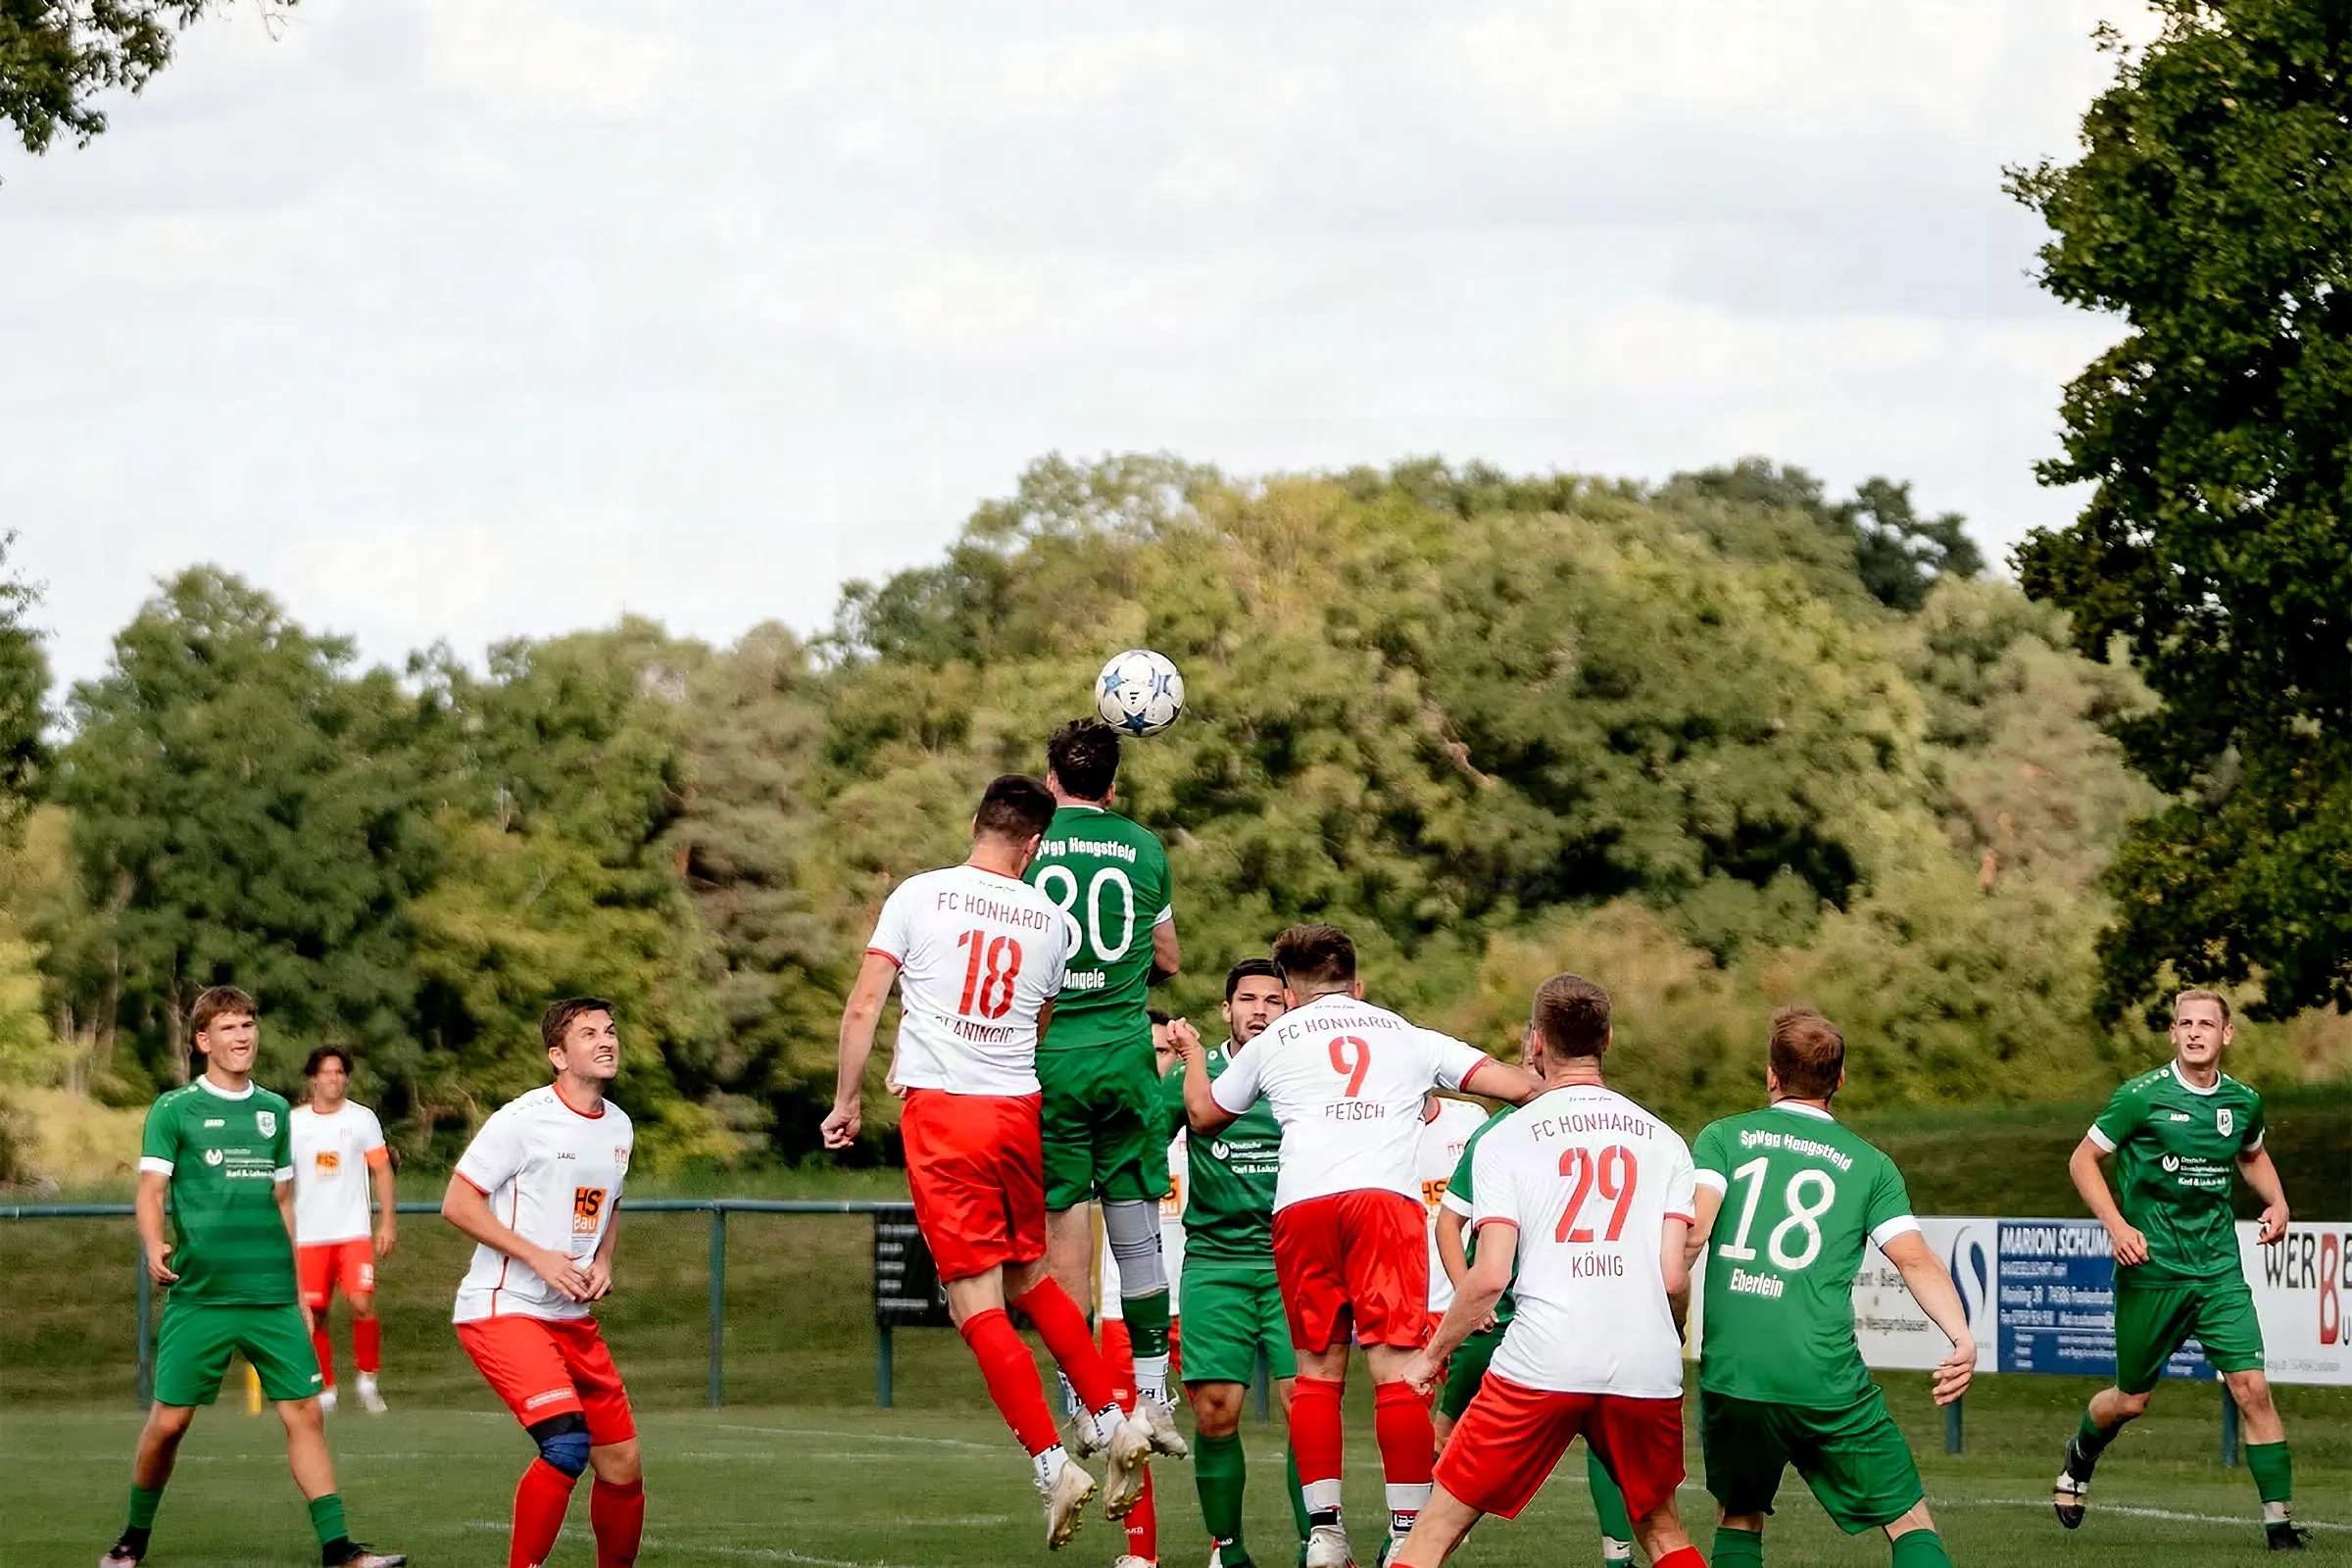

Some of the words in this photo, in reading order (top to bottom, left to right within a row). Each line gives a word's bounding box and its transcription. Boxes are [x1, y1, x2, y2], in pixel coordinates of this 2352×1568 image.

[1036, 839, 1066, 861] Vgg
[1069, 836, 1137, 863] Hengstfeld
[937, 892, 958, 911] FC
[965, 894, 1051, 933] HONHARDT
[1034, 864, 1135, 961] 80
[956, 929, 1022, 1020] 18
[1062, 967, 1105, 989] Angele
[1278, 1024, 1299, 1046] FC
[1305, 1016, 1401, 1033] HONHARDT
[1328, 1035, 1371, 1098] 9
[1325, 1102, 1385, 1120] FETSCH
[1531, 1119, 1555, 1142] FC
[1558, 1112, 1656, 1141] HONHARDT
[1740, 1130, 1782, 1149] SpVgg
[1784, 1133, 1853, 1172] Hengstfeld
[574, 1188, 603, 1216] HS
[1555, 1145, 1638, 1243] 29
[1719, 1156, 1836, 1270] 18
[2000, 1226, 2057, 1255] MARION
[1572, 1250, 1624, 1279] KÖNIG
[1730, 1267, 1785, 1298] Eberlein
